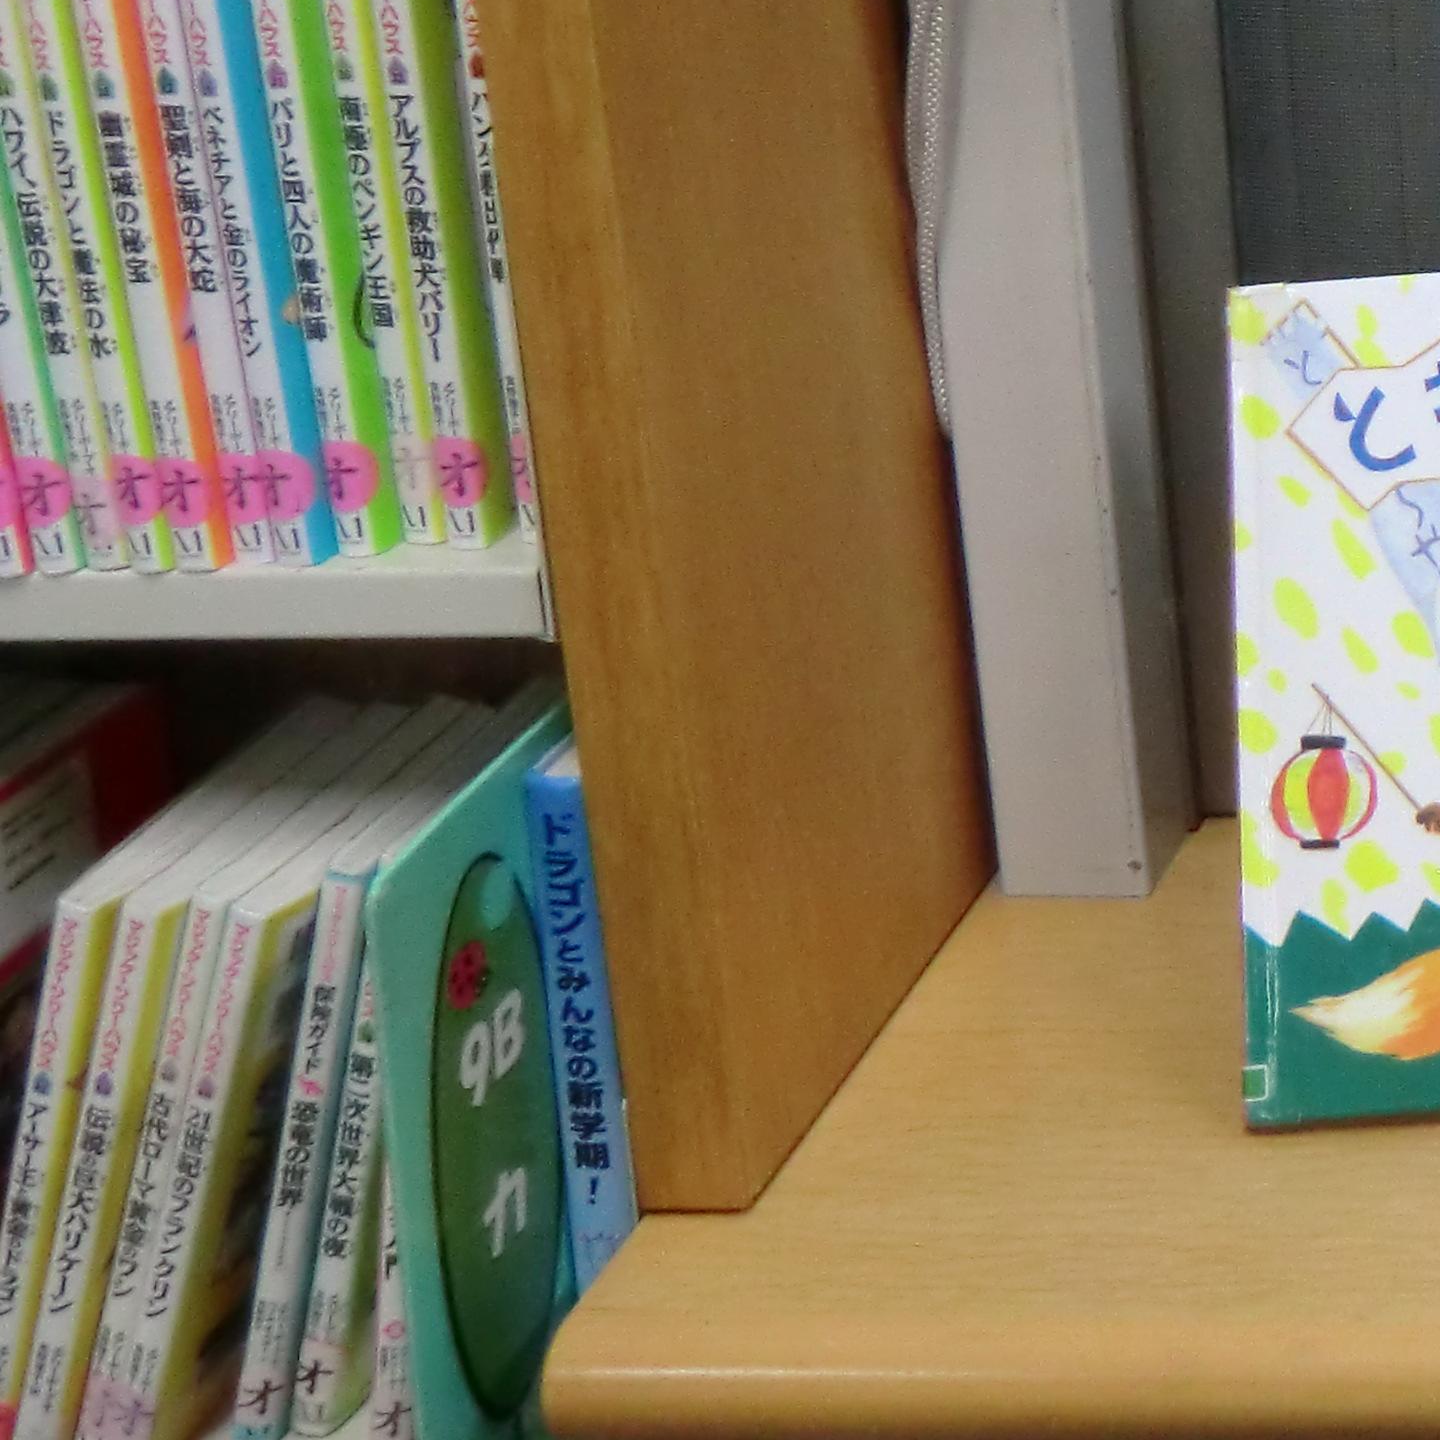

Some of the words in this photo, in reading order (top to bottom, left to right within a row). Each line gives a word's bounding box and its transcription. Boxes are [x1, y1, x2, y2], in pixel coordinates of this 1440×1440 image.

[388, 92, 444, 363] アルプスの救助犬バリー
[541, 811, 612, 1205] ドラゴンとみんなの新学期!
